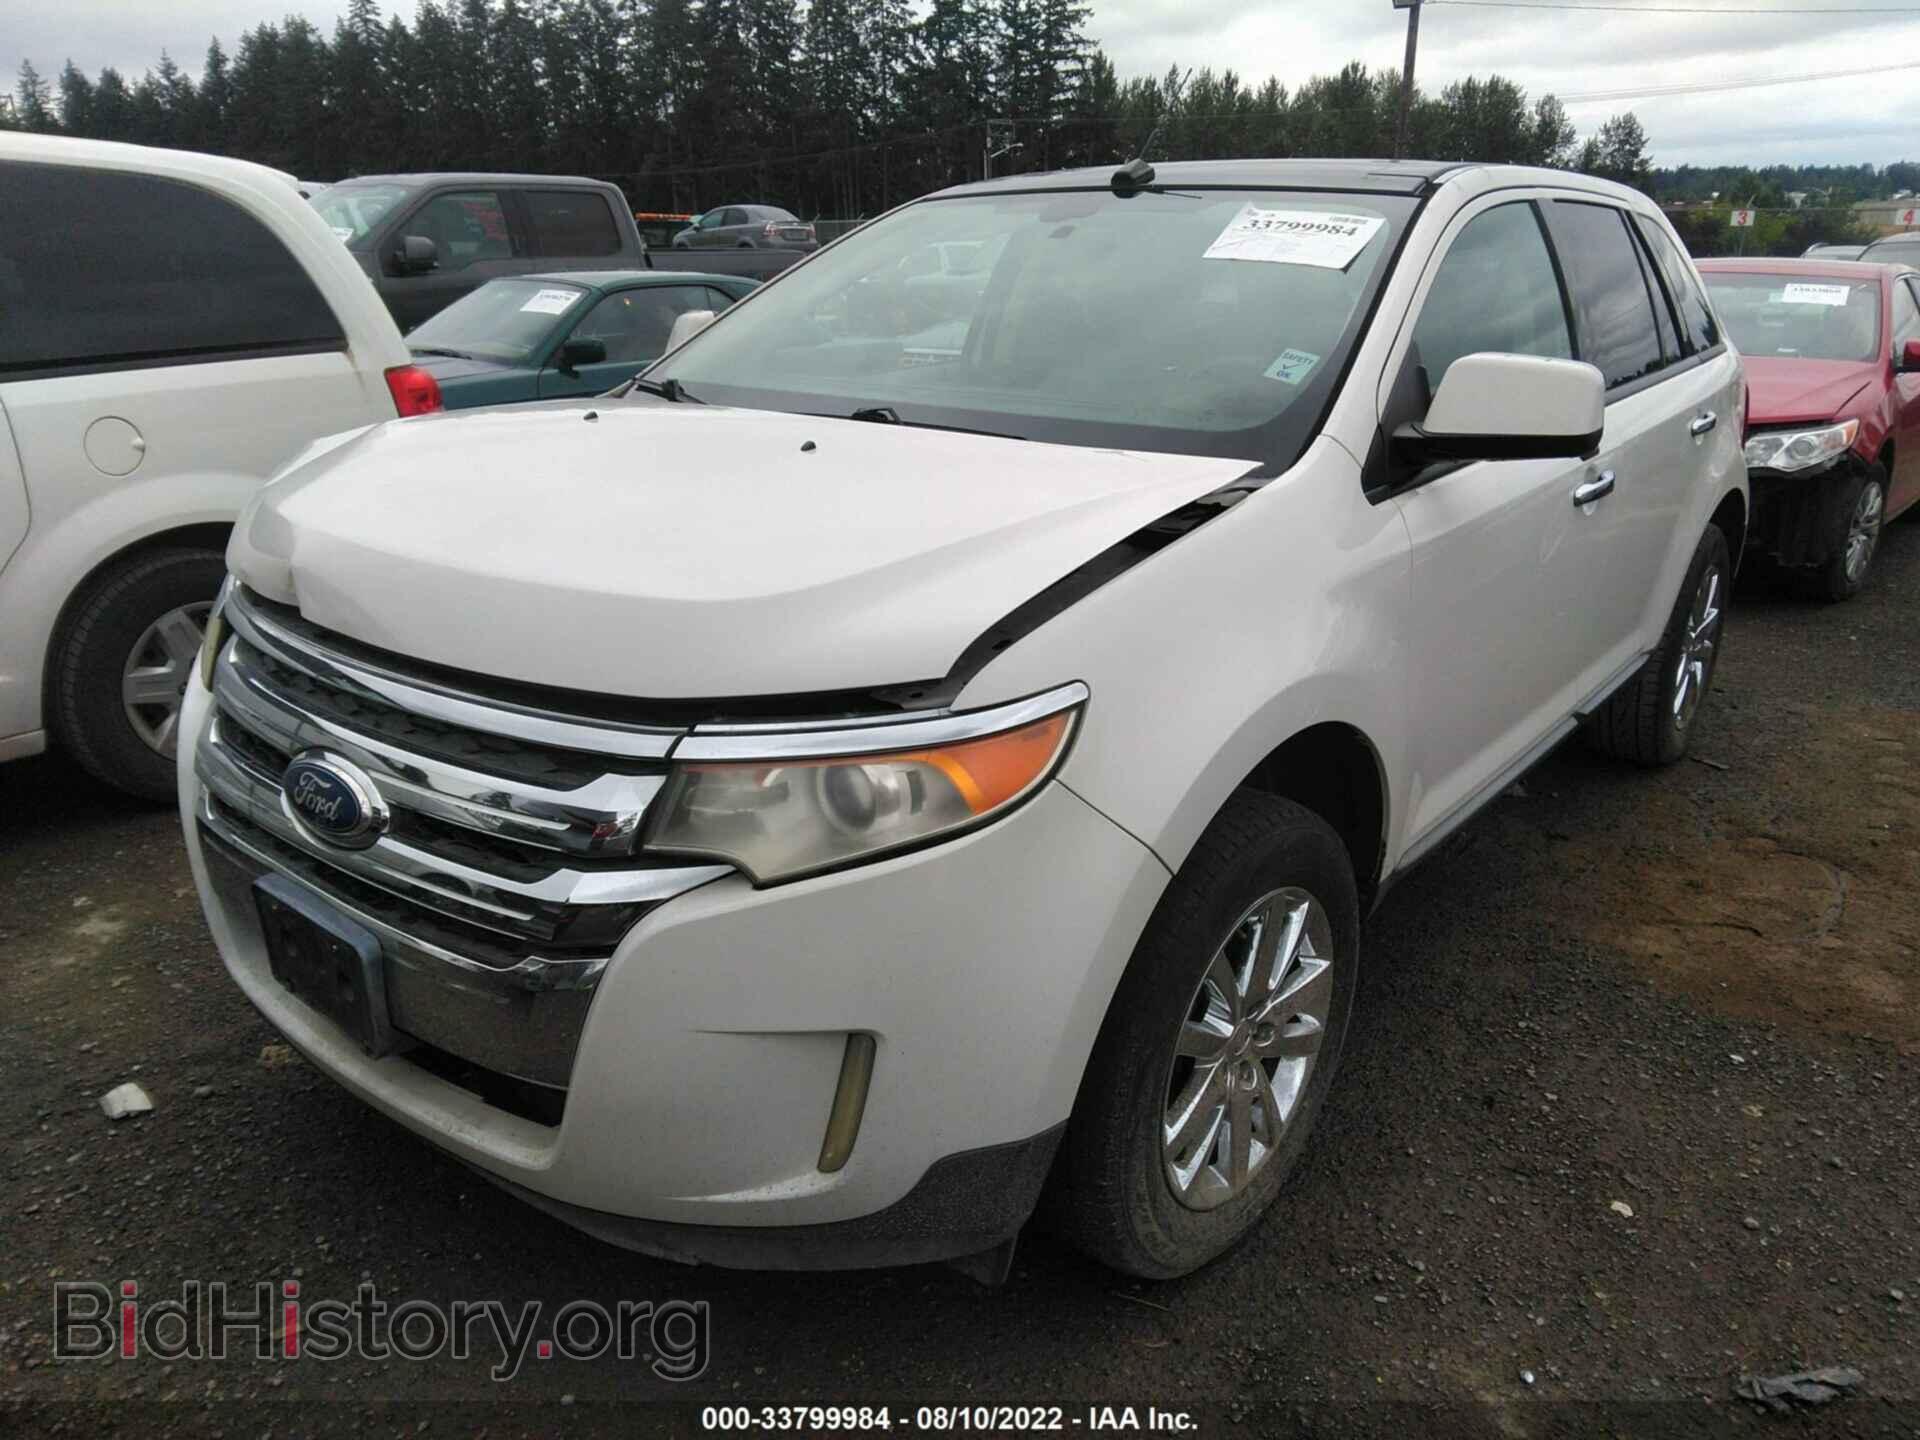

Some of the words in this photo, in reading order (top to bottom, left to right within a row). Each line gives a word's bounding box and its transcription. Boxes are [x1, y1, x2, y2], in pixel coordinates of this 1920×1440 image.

[1737, 208, 1748, 226] 3
[1903, 208, 1915, 225] 4
[1243, 219, 1358, 237] 33799984
[294, 771, 343, 821] Ford
